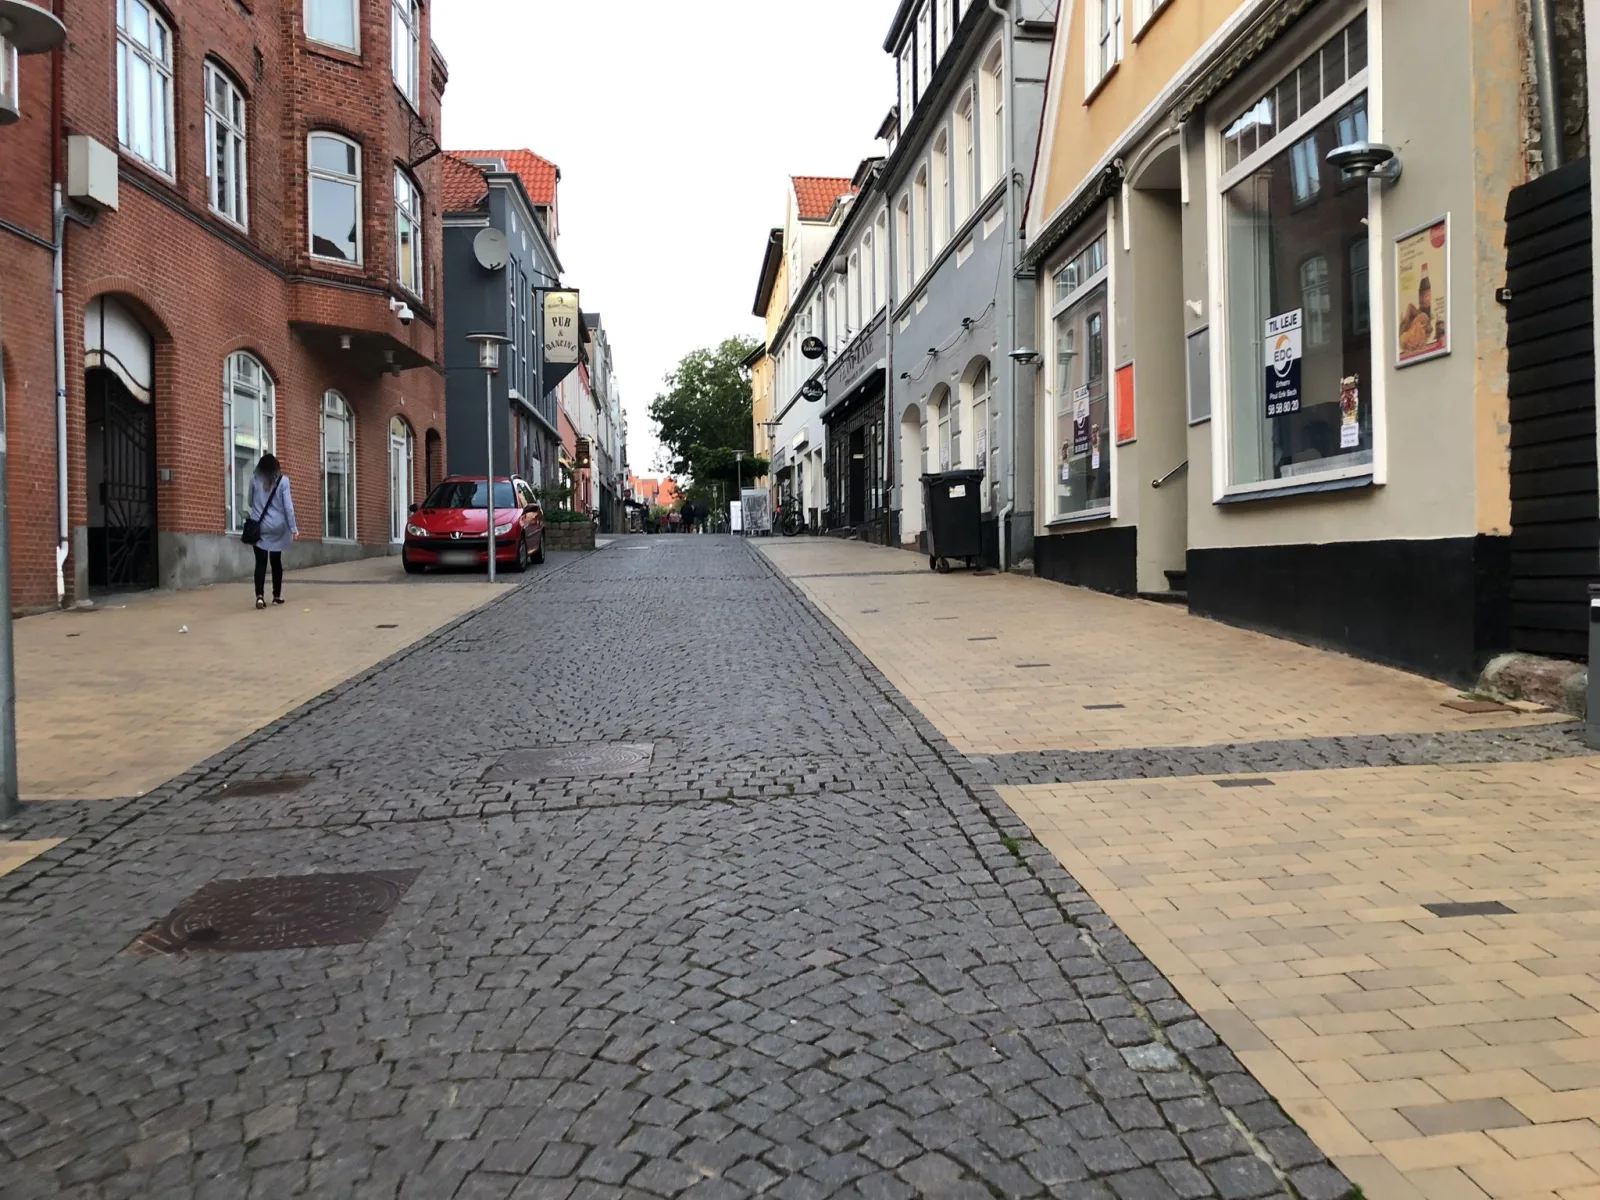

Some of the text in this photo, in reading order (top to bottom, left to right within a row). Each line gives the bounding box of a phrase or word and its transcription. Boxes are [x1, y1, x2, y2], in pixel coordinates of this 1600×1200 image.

[551, 316, 571, 327] PUB
[1269, 313, 1297, 333] TIL LEJE
[557, 329, 564, 337] &
[545, 339, 577, 352] DANCING
[1274, 347, 1292, 362] EDC
[1291, 399, 1299, 411] 20
